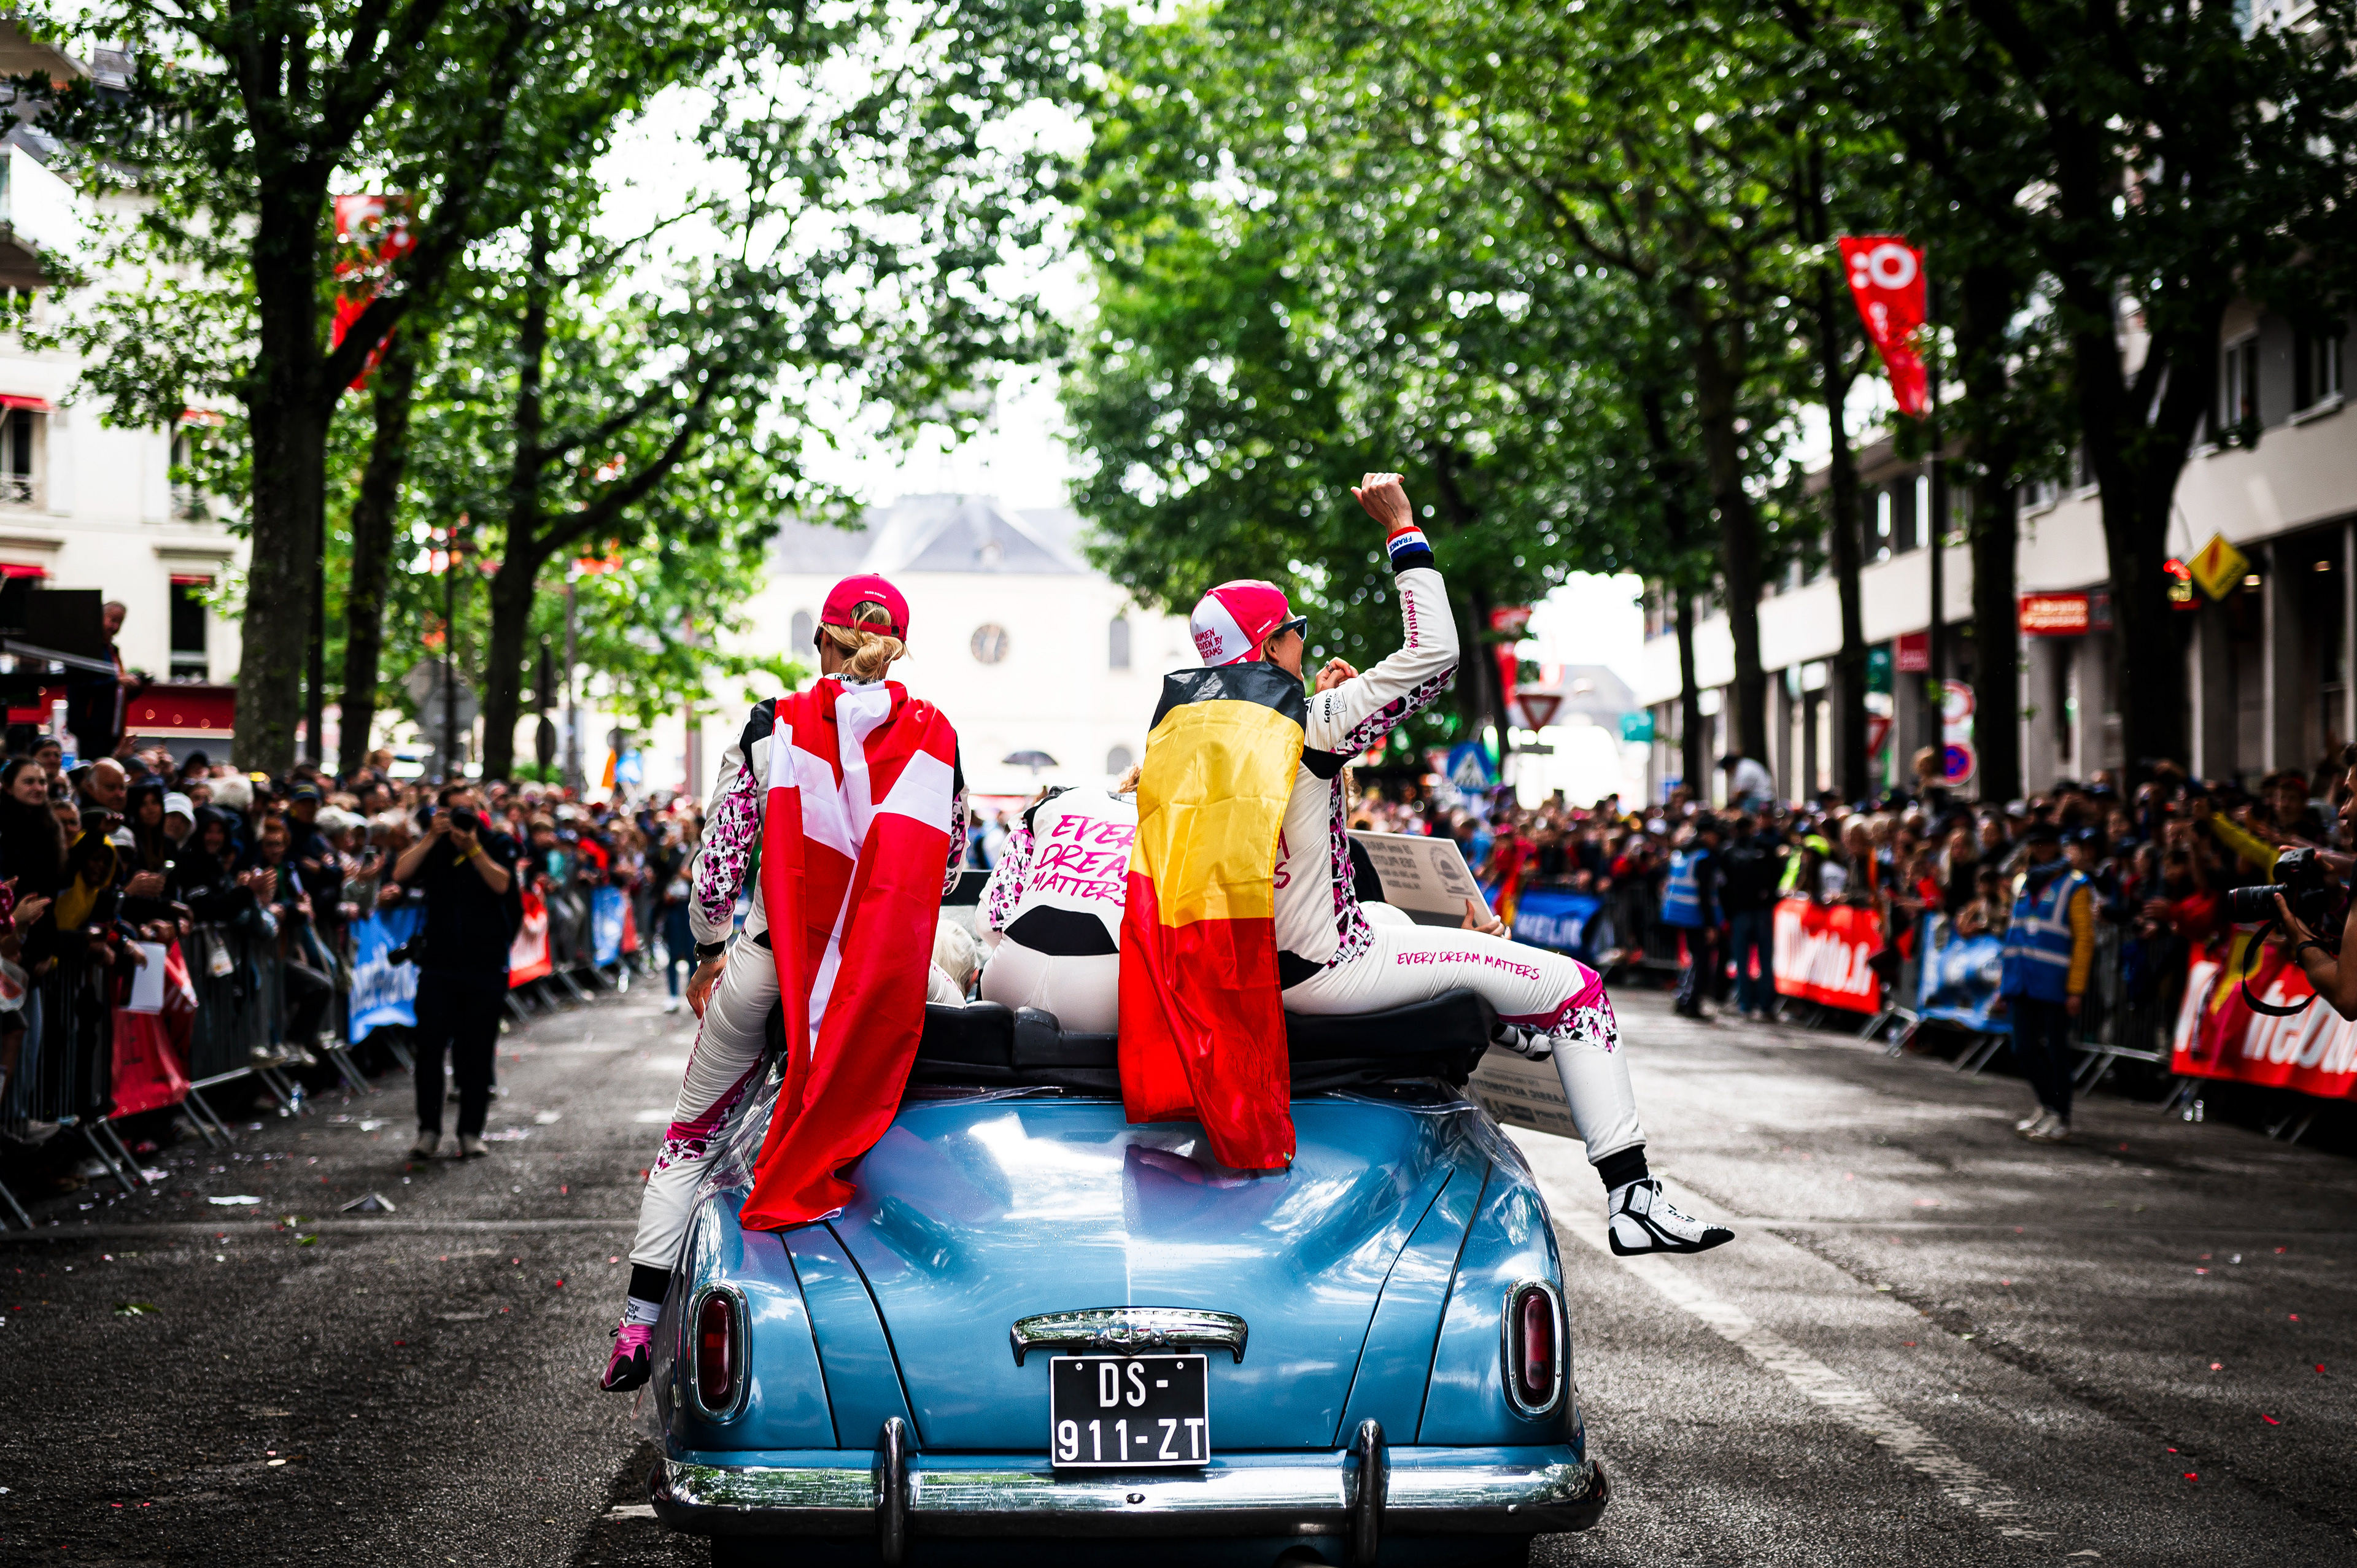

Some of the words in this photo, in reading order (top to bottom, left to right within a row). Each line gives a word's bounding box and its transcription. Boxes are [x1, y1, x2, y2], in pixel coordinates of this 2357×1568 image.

[1389, 536, 1412, 552] FRANCE
[1405, 590, 1418, 630] DAMES
[1194, 627, 1215, 642] WOMEN
[1214, 635, 1223, 646] BY
[1051, 815, 1137, 849] EVER
[1397, 952, 1436, 965] EVERY
[1439, 951, 1480, 965] DREAM
[1485, 955, 1540, 980] MATTERS
[1099, 1362, 1168, 1408] DS-
[1058, 1418, 1204, 1461] 911-ZT
